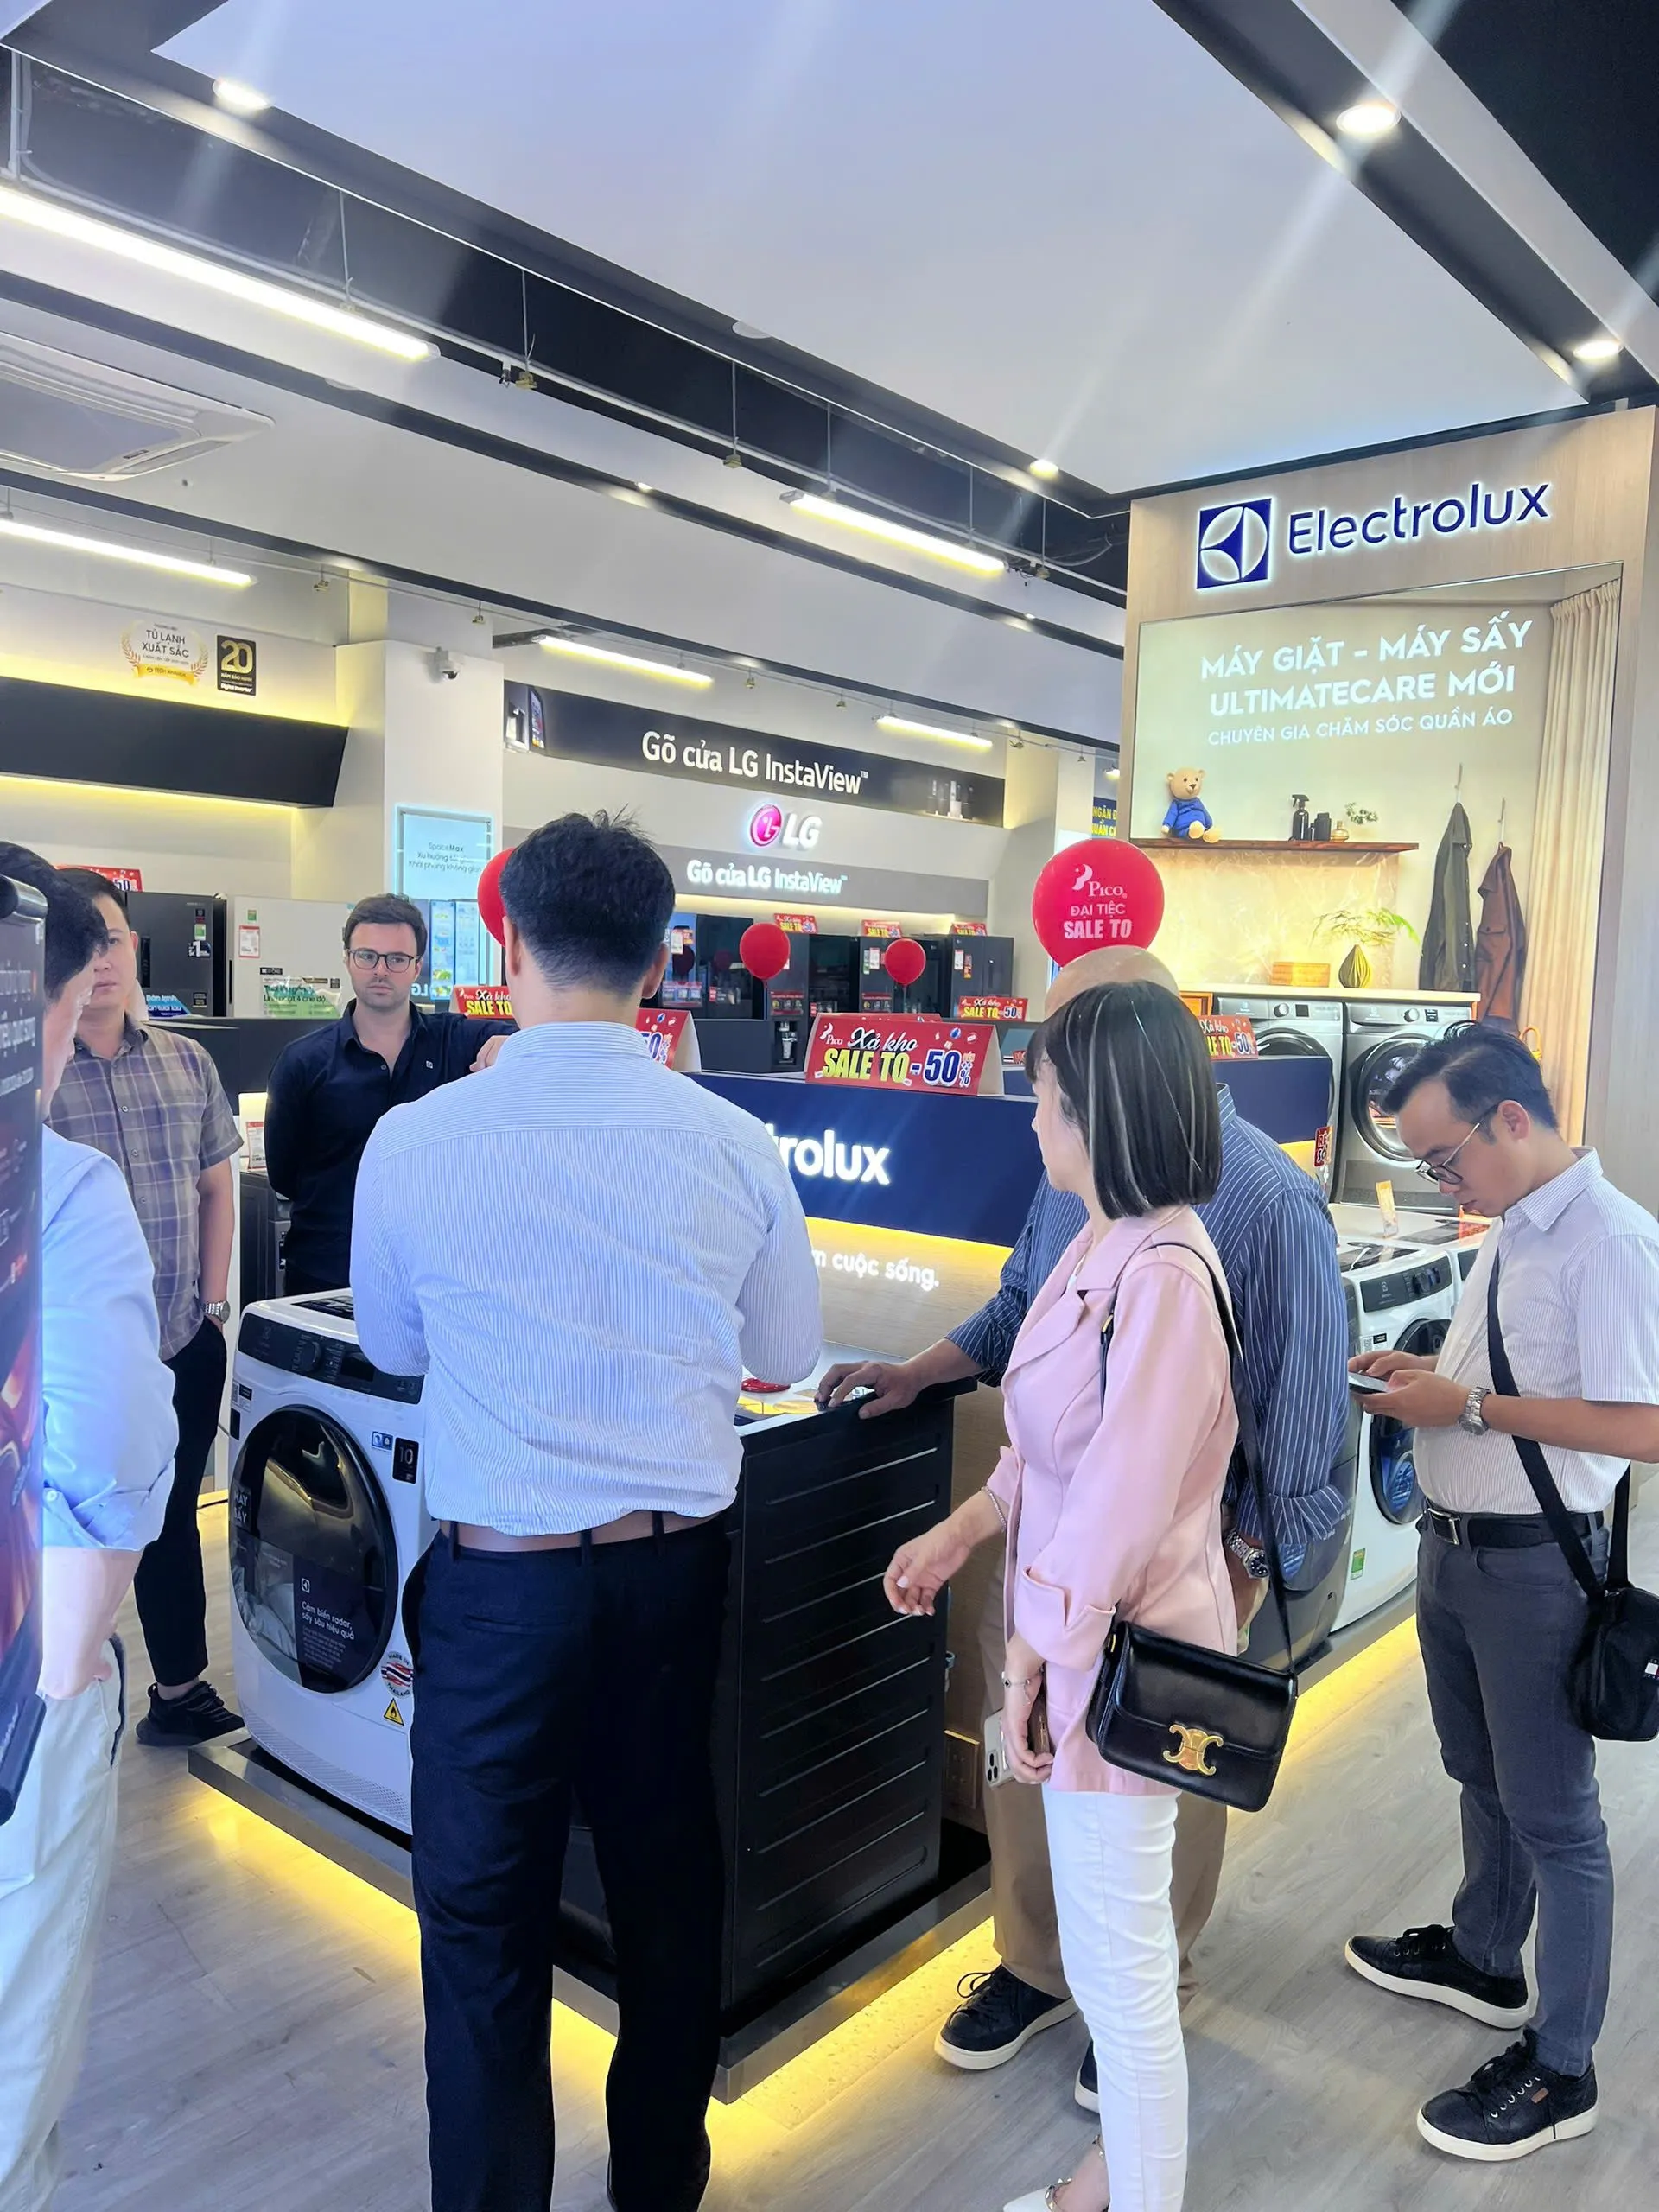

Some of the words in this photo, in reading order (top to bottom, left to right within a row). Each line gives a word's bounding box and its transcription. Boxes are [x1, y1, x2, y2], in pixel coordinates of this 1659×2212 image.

[1288, 482, 1550, 556] Electrolux
[142, 641, 167, 655] XUẤT
[161, 631, 186, 645] LẠNH
[1201, 645, 1264, 680] MÁY
[1273, 635, 1345, 676] GIẶT
[1379, 624, 1452, 663] MÁY
[1460, 610, 1533, 654] SẤY
[220, 639, 253, 674] 20
[1210, 672, 1437, 717] ULTIMATECARE
[1447, 660, 1516, 697] MỚI
[1208, 726, 1275, 746] CHUYÊN
[1281, 726, 1311, 741] GIA
[1316, 718, 1370, 737] CHĂM
[1375, 714, 1414, 733] SÓC
[1419, 706, 1476, 730] QUẦN
[1481, 706, 1514, 727] ÁO
[642, 730, 677, 764] Gõ
[683, 739, 723, 772] cửa
[728, 747, 759, 778] LG
[781, 813, 823, 849] LG
[686, 859, 714, 884] Gõ
[715, 861, 747, 888] cửa
[747, 864, 772, 890] LG
[1070, 905, 1093, 919] ĐẠI
[1096, 900, 1127, 918] TIỆC
[1063, 918, 1104, 939] SALE
[1109, 918, 1133, 938] TO
[467, 1000, 495, 1015] SALE
[497, 1001, 512, 1015] TO
[963, 1007, 985, 1018] SALE
[987, 1007, 999, 1019] TO
[847, 1027, 880, 1051] Xả
[882, 1031, 919, 1052] kho
[1219, 1035, 1232, 1057] TO
[823, 1048, 875, 1080] SALE
[880, 1051, 911, 1084] TO
[832, 1252, 880, 1279] cuộc
[885, 1257, 940, 1292] sống.
[399, 1446, 414, 1465] 10
